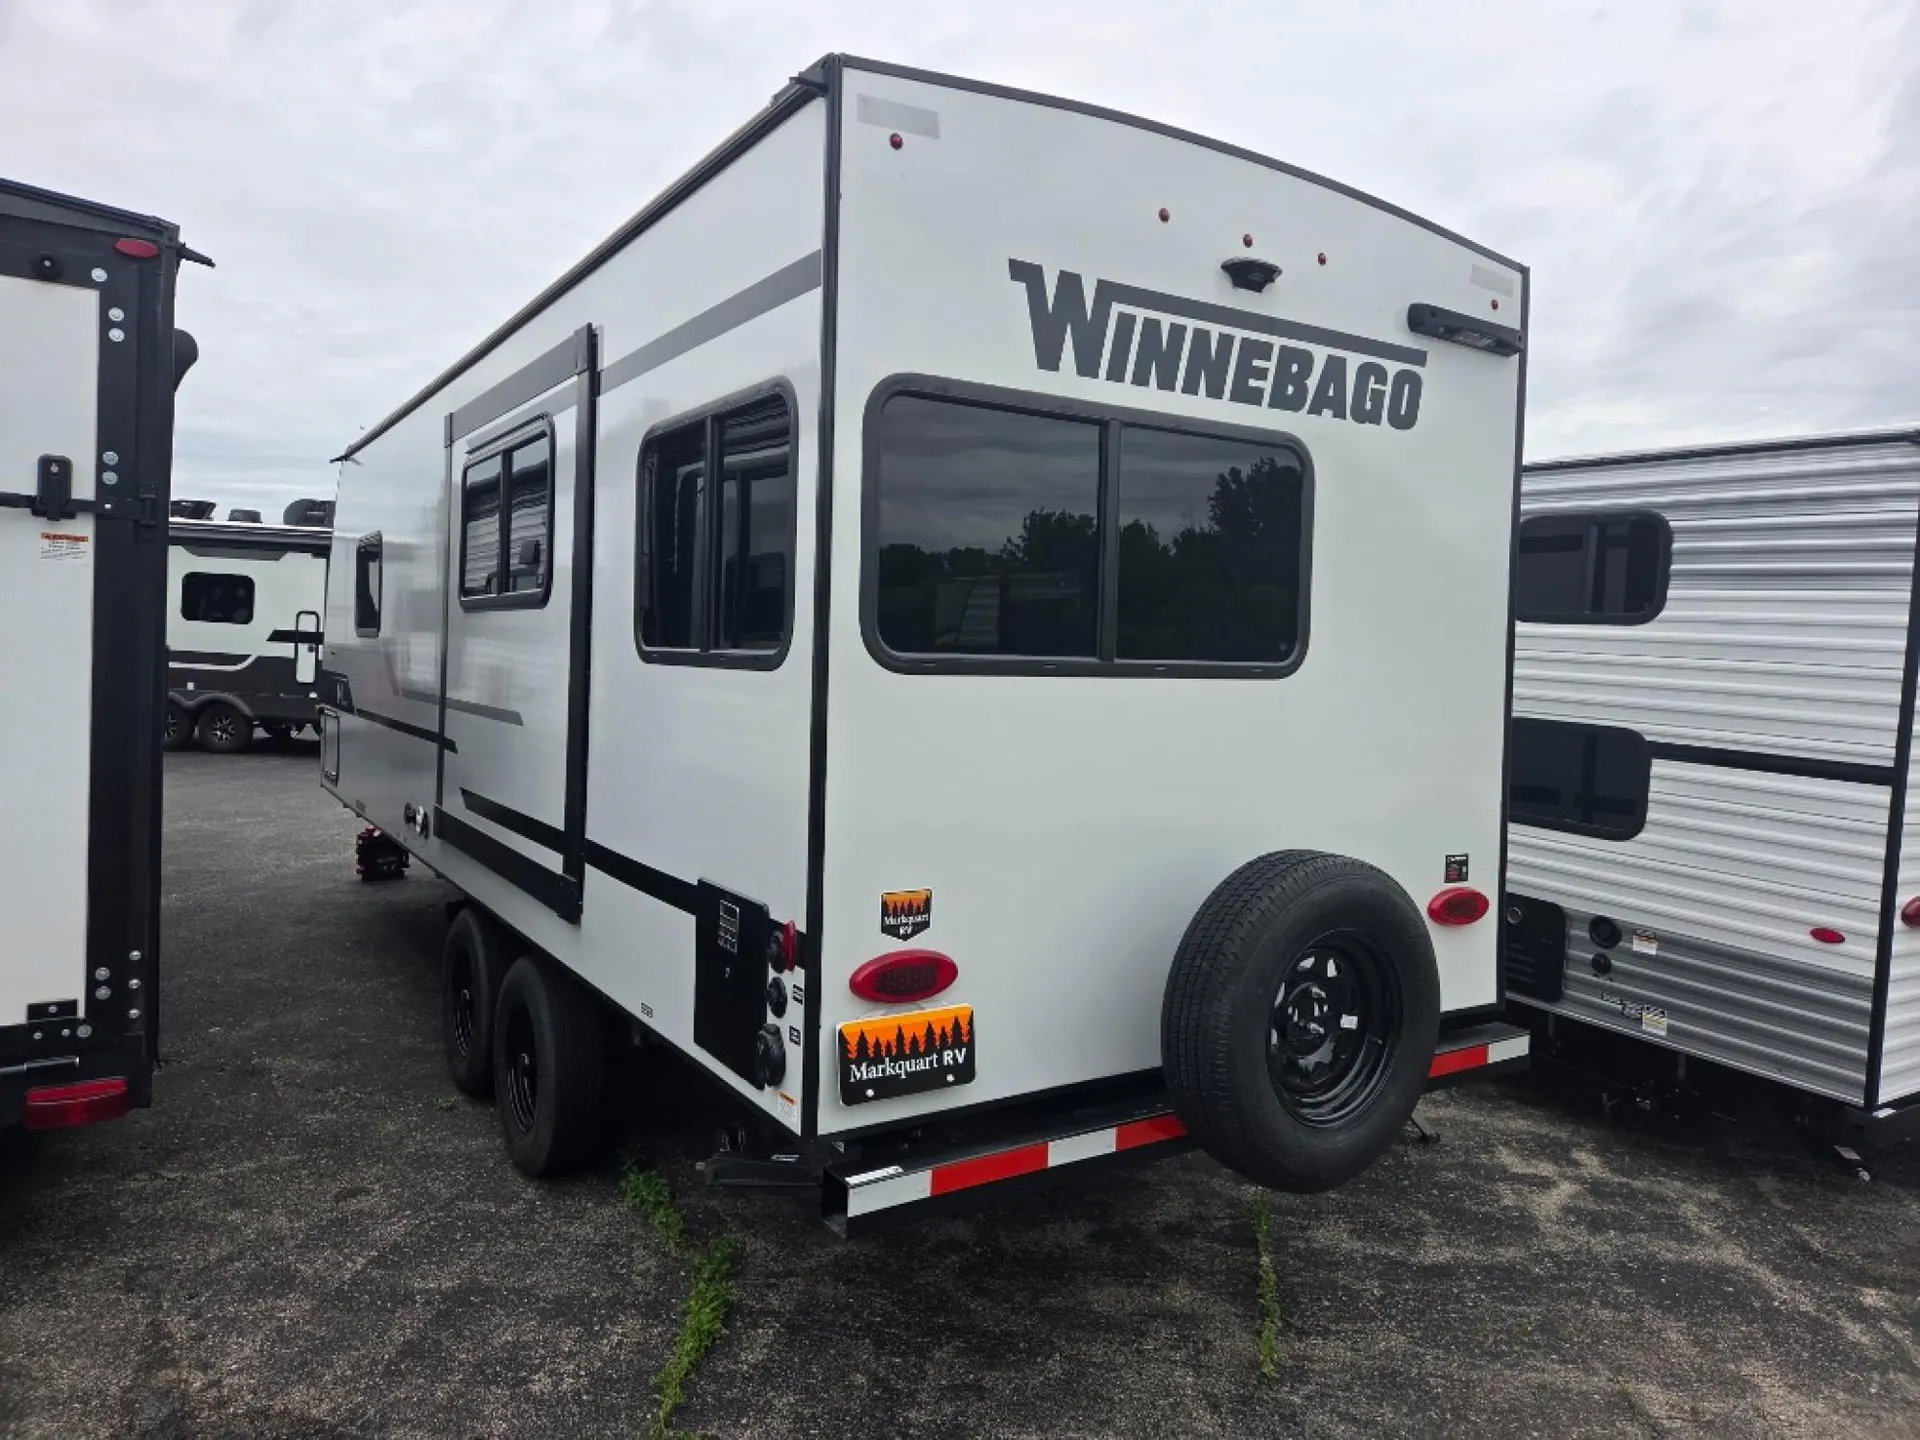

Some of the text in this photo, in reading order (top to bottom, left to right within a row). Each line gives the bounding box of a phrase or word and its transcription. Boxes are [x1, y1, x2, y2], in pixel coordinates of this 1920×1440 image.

[1008, 257, 1428, 430] WINNEBAGO
[884, 913, 929, 926] Markquart
[899, 925, 914, 936] RV
[849, 1047, 967, 1083] Markquart RV
